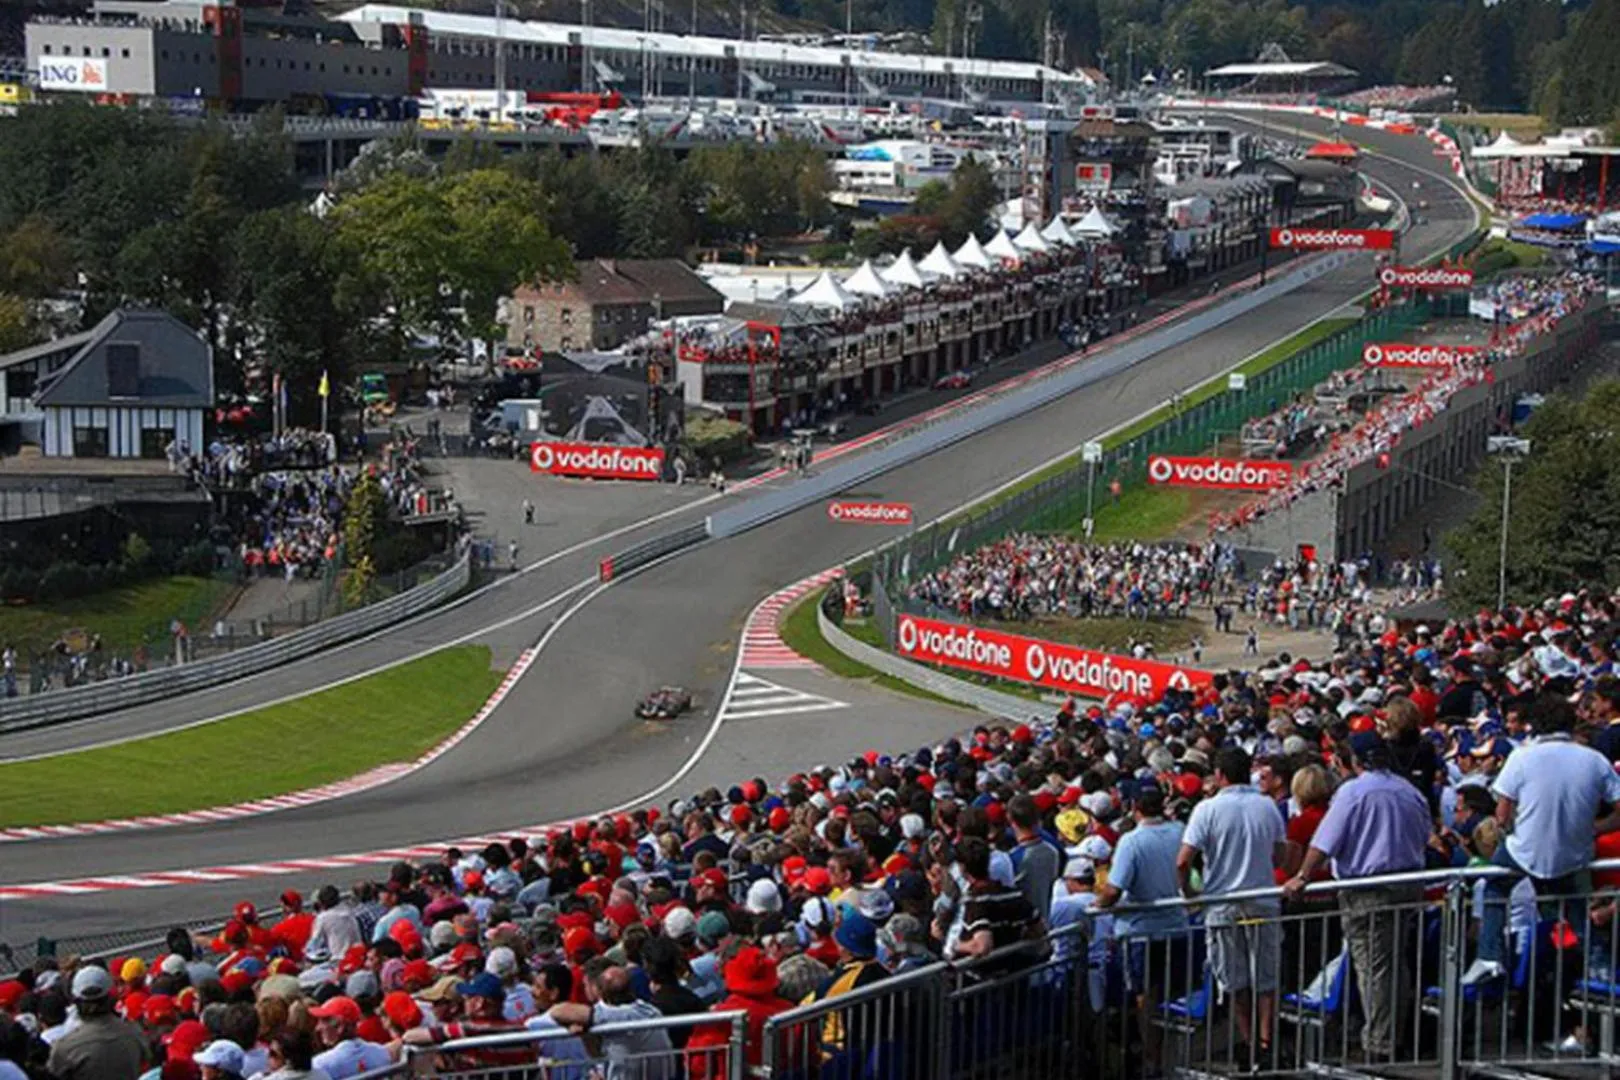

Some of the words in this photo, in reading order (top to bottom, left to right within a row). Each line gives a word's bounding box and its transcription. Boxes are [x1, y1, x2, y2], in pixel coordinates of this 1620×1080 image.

[42, 64, 78, 84] ING
[1295, 229, 1365, 246] vodafone
[1396, 269, 1472, 284] vodafone
[845, 504, 908, 519] vodafone
[919, 628, 1011, 668] vodafone
[1048, 653, 1152, 696] vodafone
